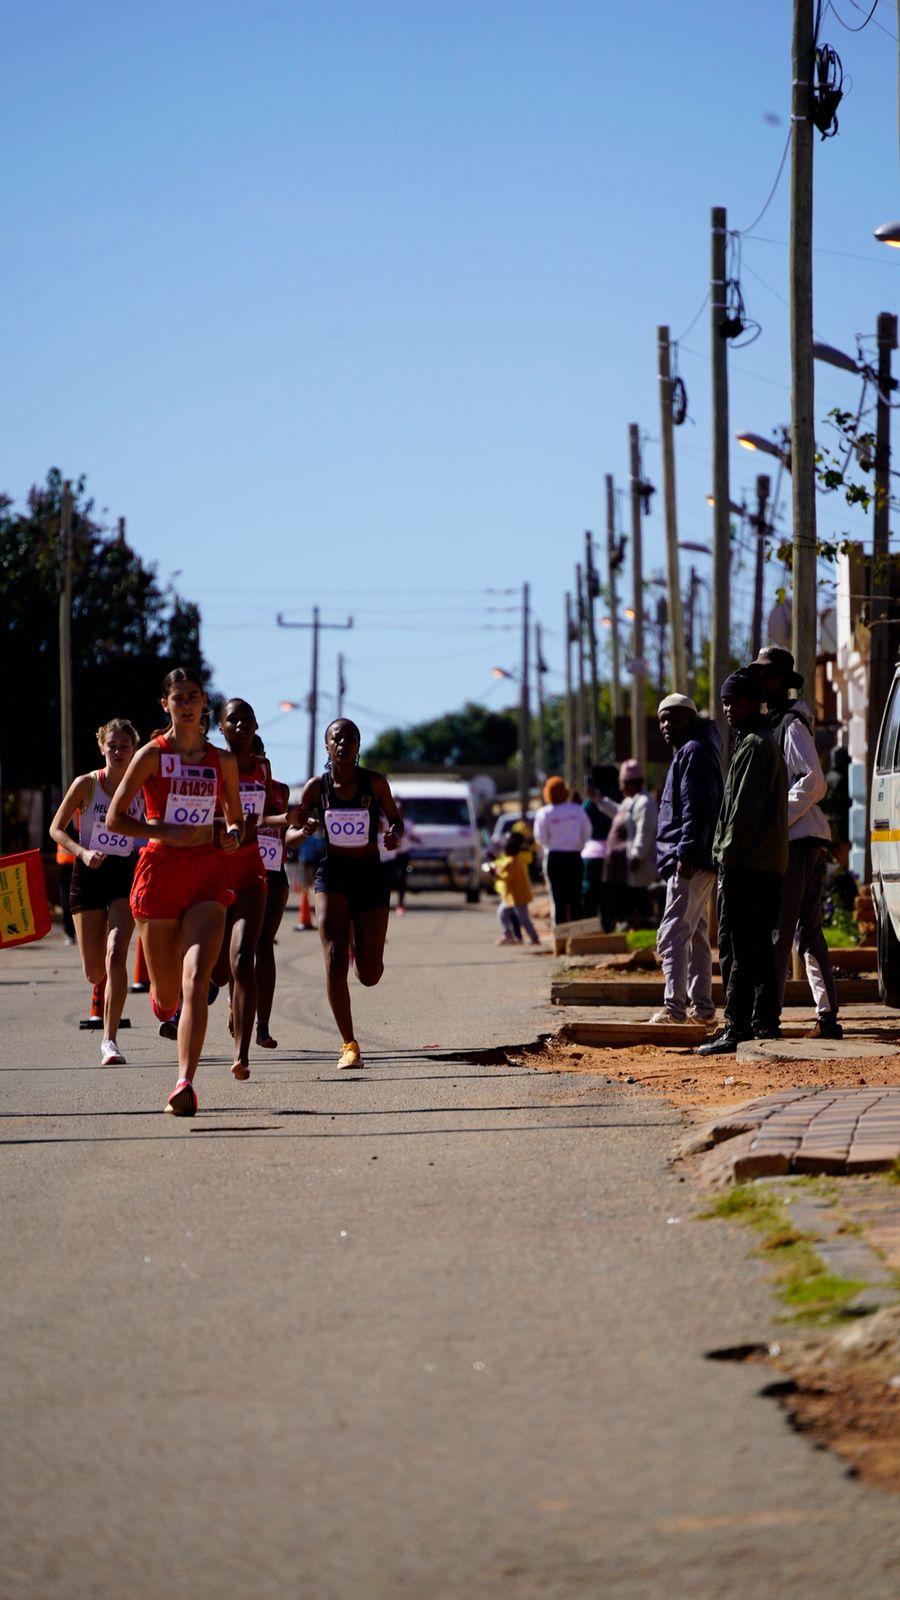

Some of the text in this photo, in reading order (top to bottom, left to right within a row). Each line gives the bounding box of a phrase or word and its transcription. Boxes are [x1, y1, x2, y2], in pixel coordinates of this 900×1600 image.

[165, 757, 175, 774] J
[174, 807, 210, 824] 067
[244, 803, 256, 815] 51
[330, 821, 365, 836] 002
[98, 832, 128, 848] 056
[259, 846, 277, 860] 09
